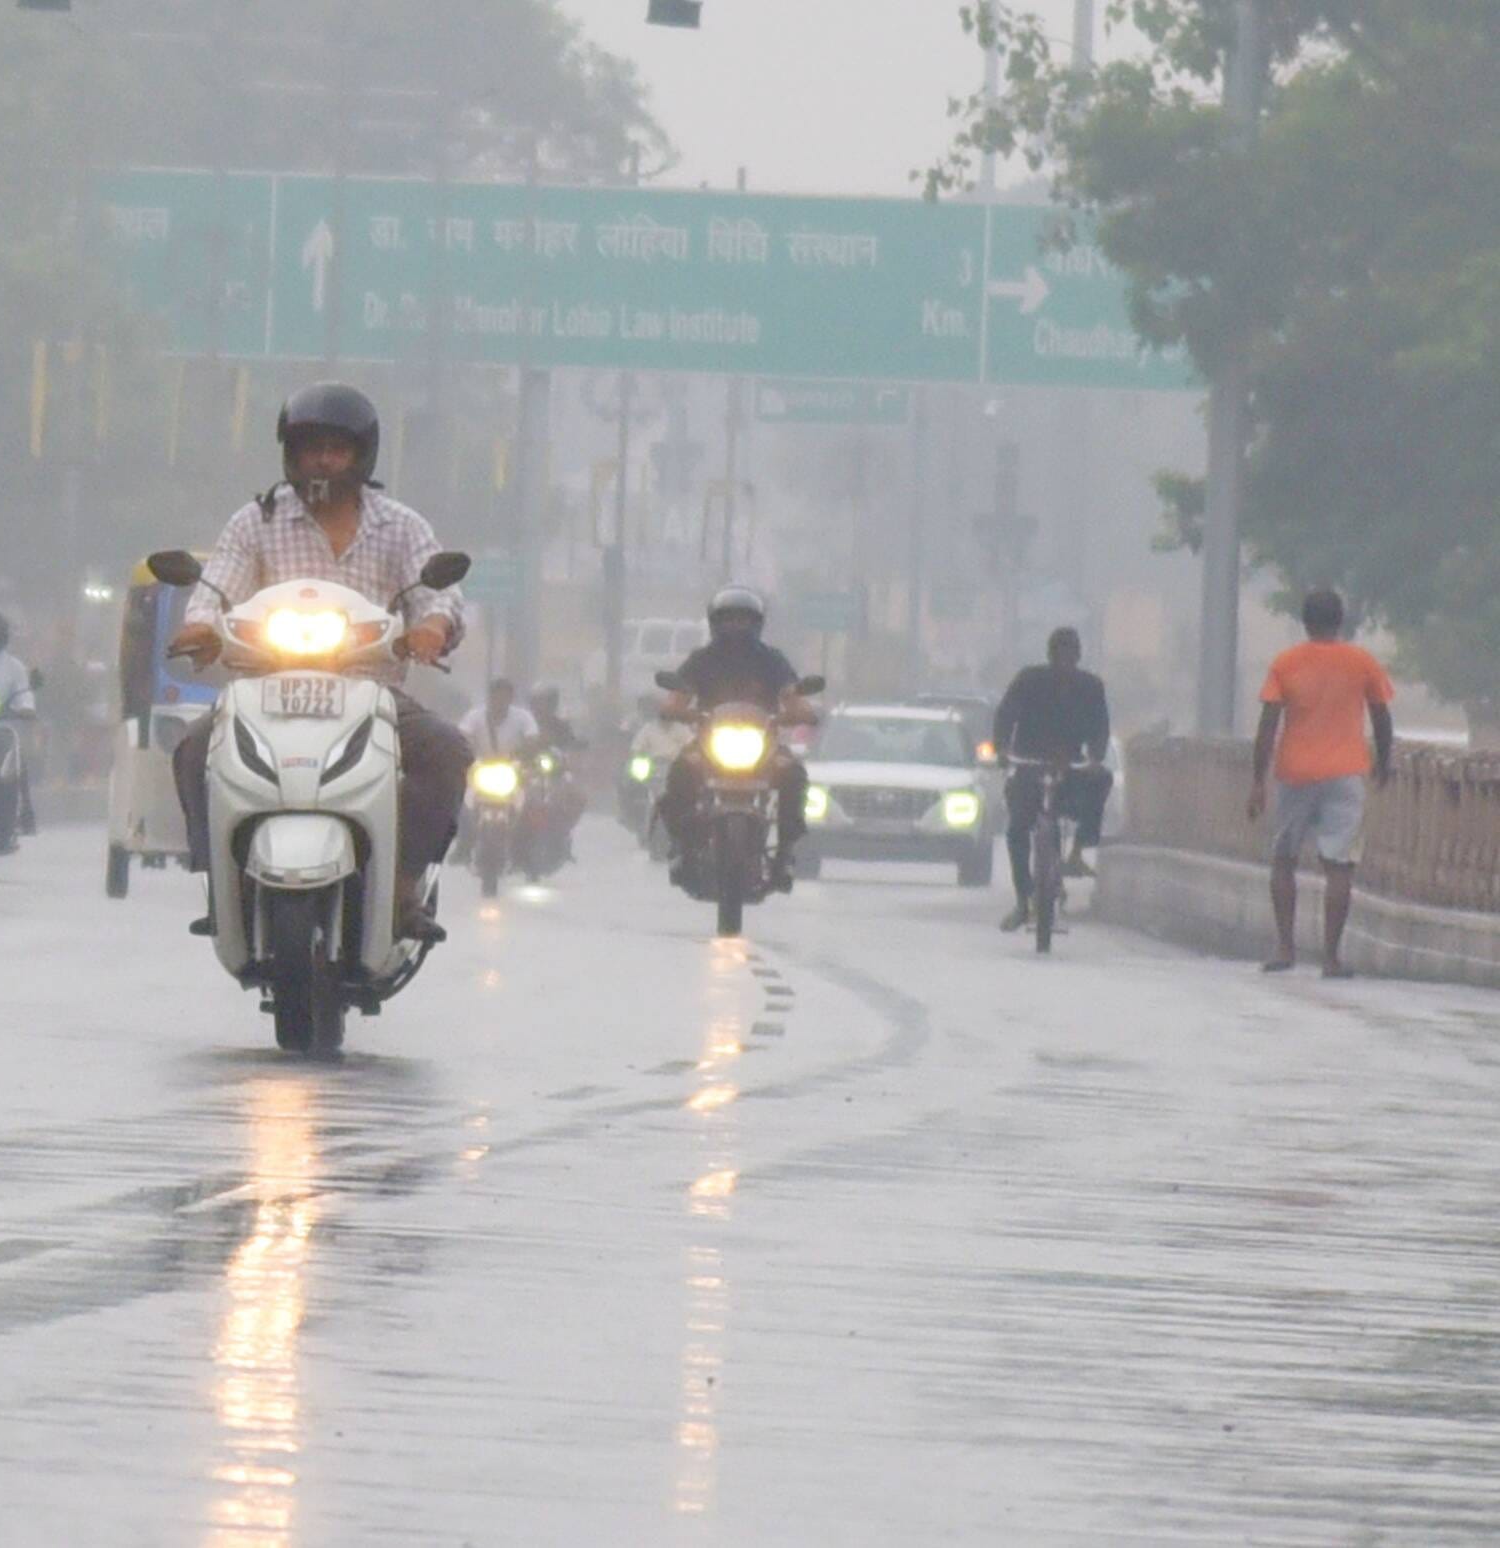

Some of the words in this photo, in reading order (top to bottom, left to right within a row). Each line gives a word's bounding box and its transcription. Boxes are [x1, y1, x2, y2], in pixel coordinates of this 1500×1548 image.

[620, 303, 662, 340] Law
[668, 304, 762, 346] Institute
[280, 678, 336, 696] UP32P
